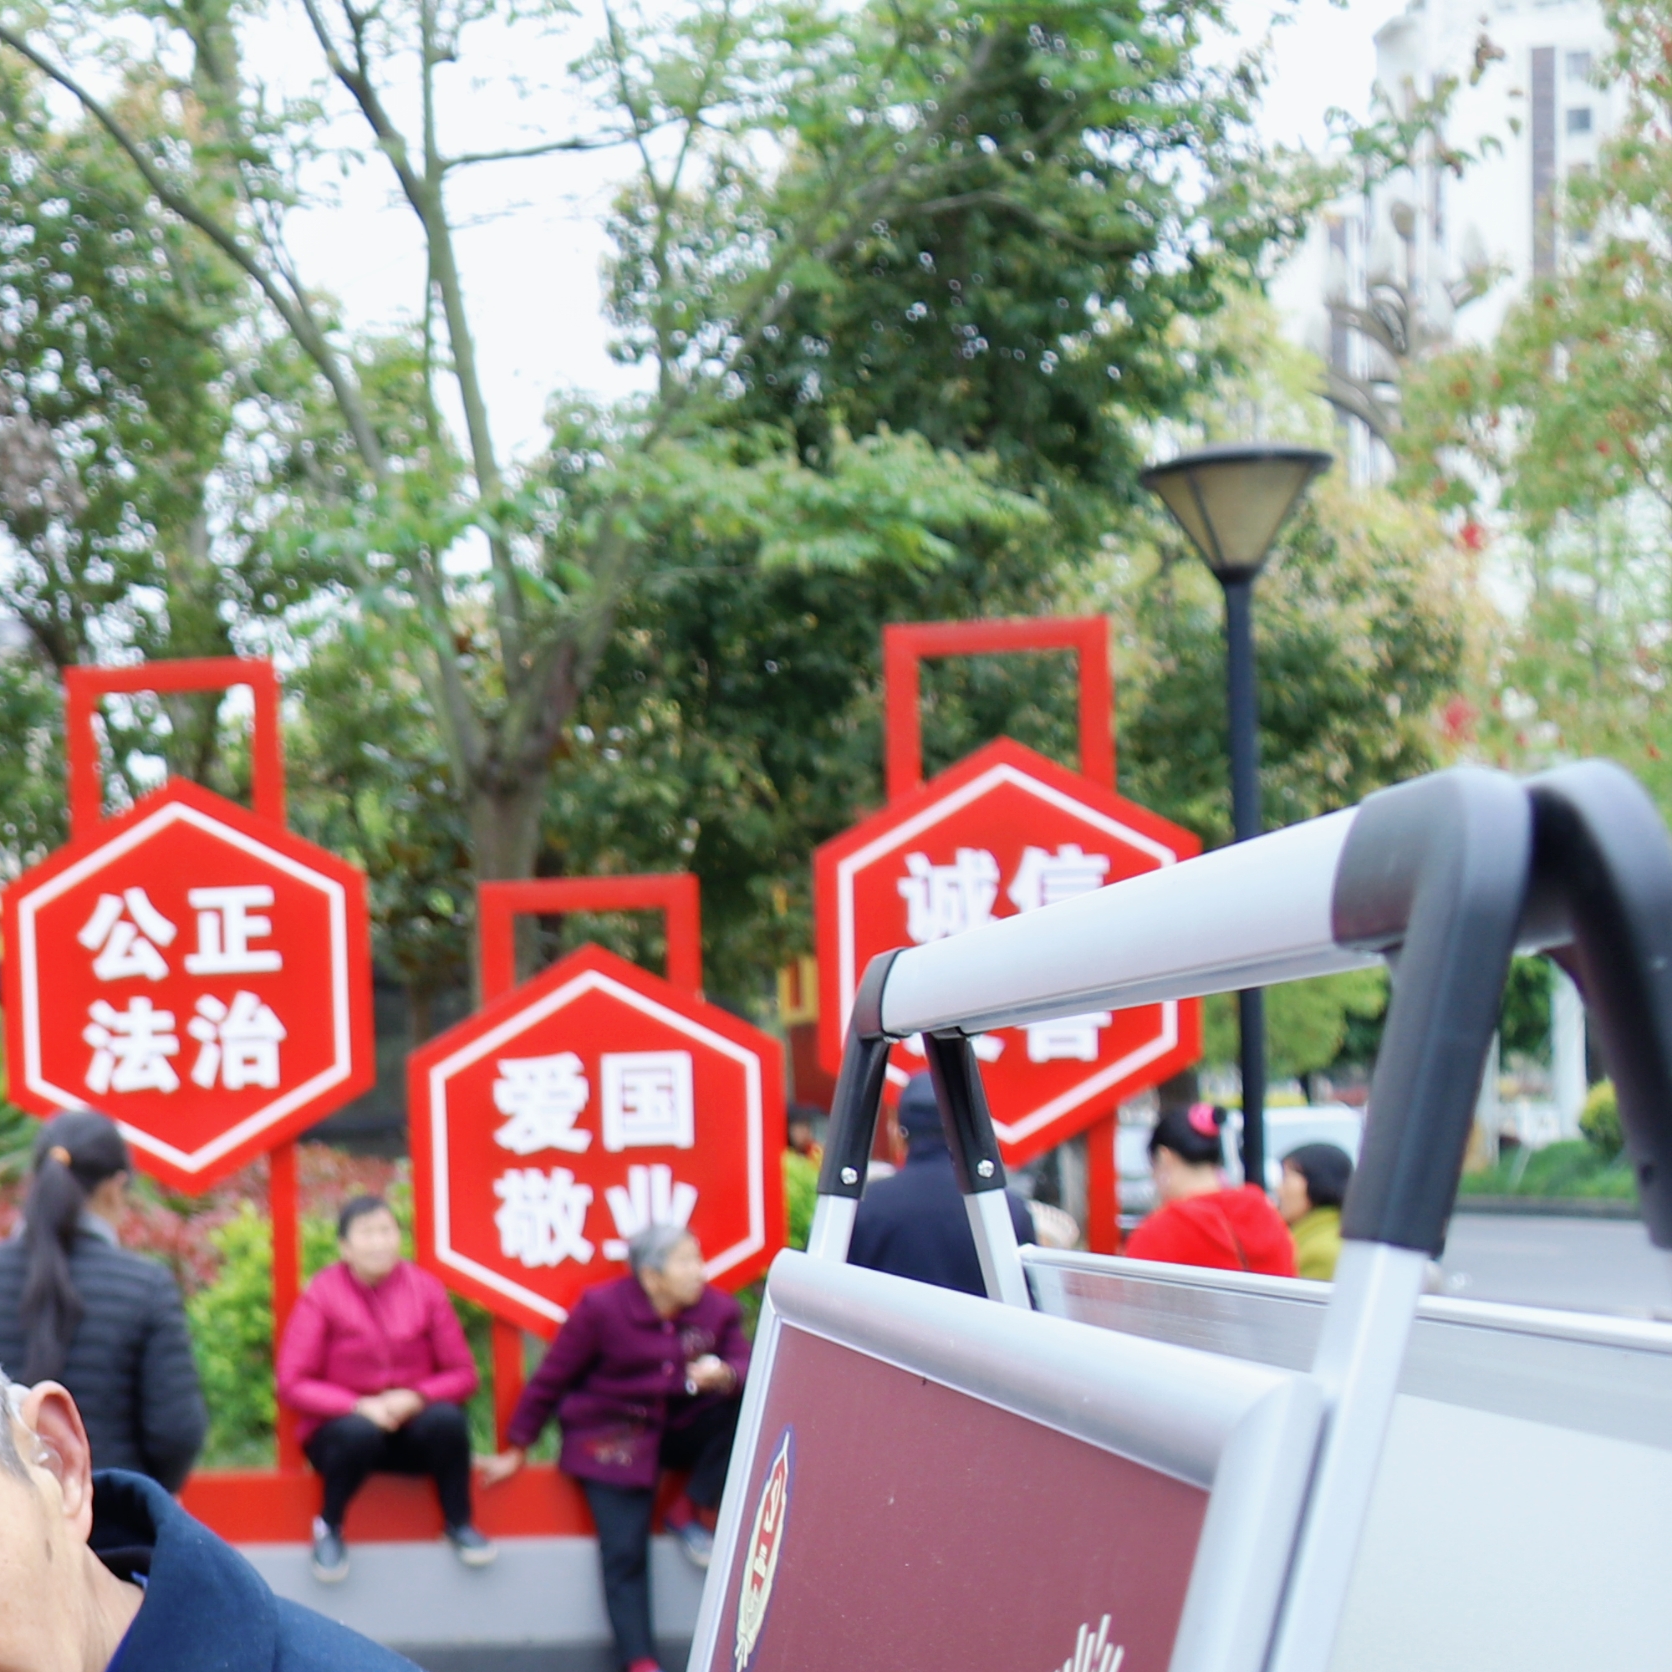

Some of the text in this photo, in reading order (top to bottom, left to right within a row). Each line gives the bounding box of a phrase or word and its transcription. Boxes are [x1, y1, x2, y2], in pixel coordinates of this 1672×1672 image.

[77, 883, 284, 983] 公正
[897, 843, 1110, 943] 诚信
[83, 991, 288, 1094] 法治
[492, 1049, 696, 1155] 爱国
[492, 1163, 700, 1269] 敬业
